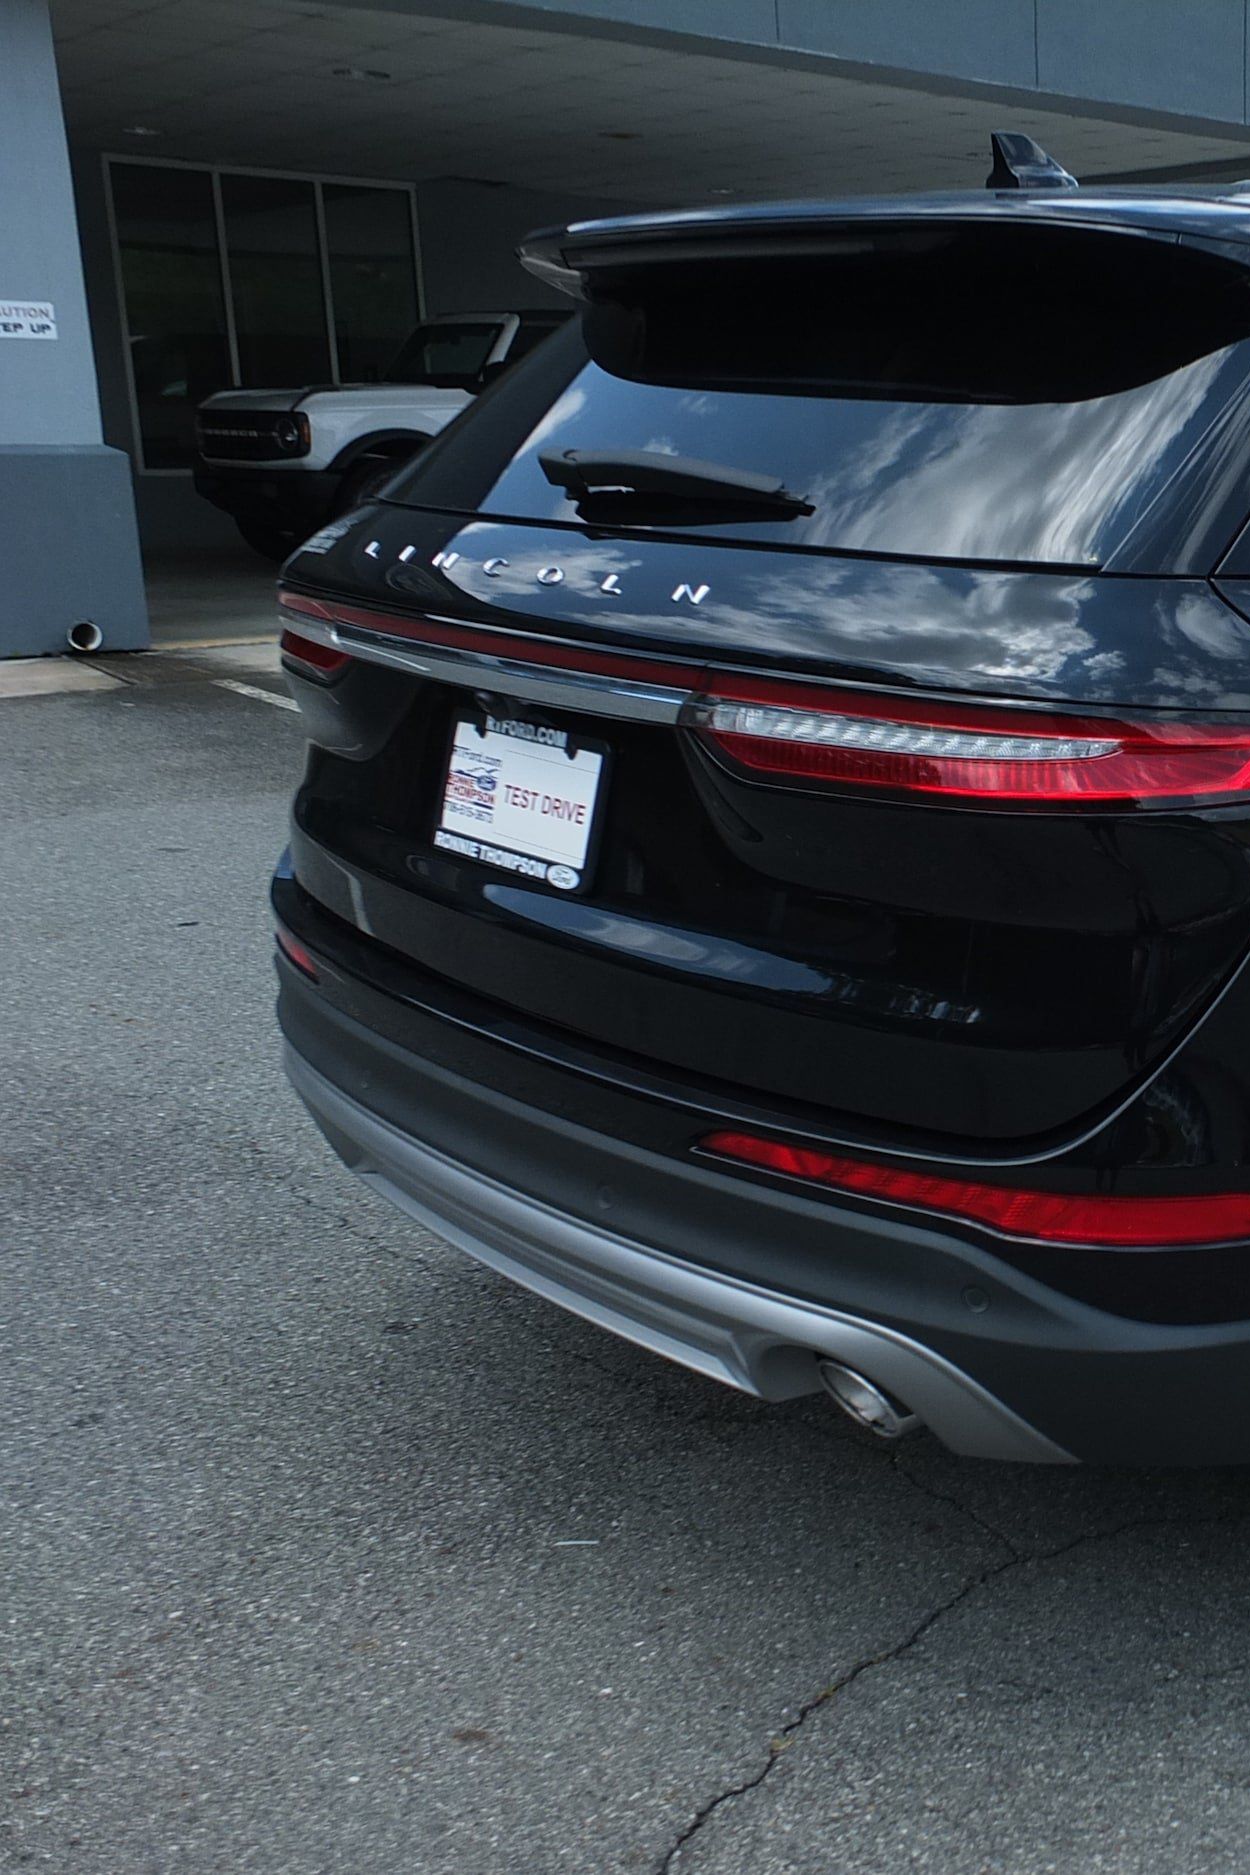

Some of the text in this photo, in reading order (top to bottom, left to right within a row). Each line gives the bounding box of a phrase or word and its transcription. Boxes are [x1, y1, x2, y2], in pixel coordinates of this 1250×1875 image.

[0, 306, 50, 319] UTION
[30, 323, 51, 334] UP
[364, 540, 710, 605] LINCOLN
[445, 782, 496, 804] THOMPSON
[504, 784, 586, 825] TEST DRIVE
